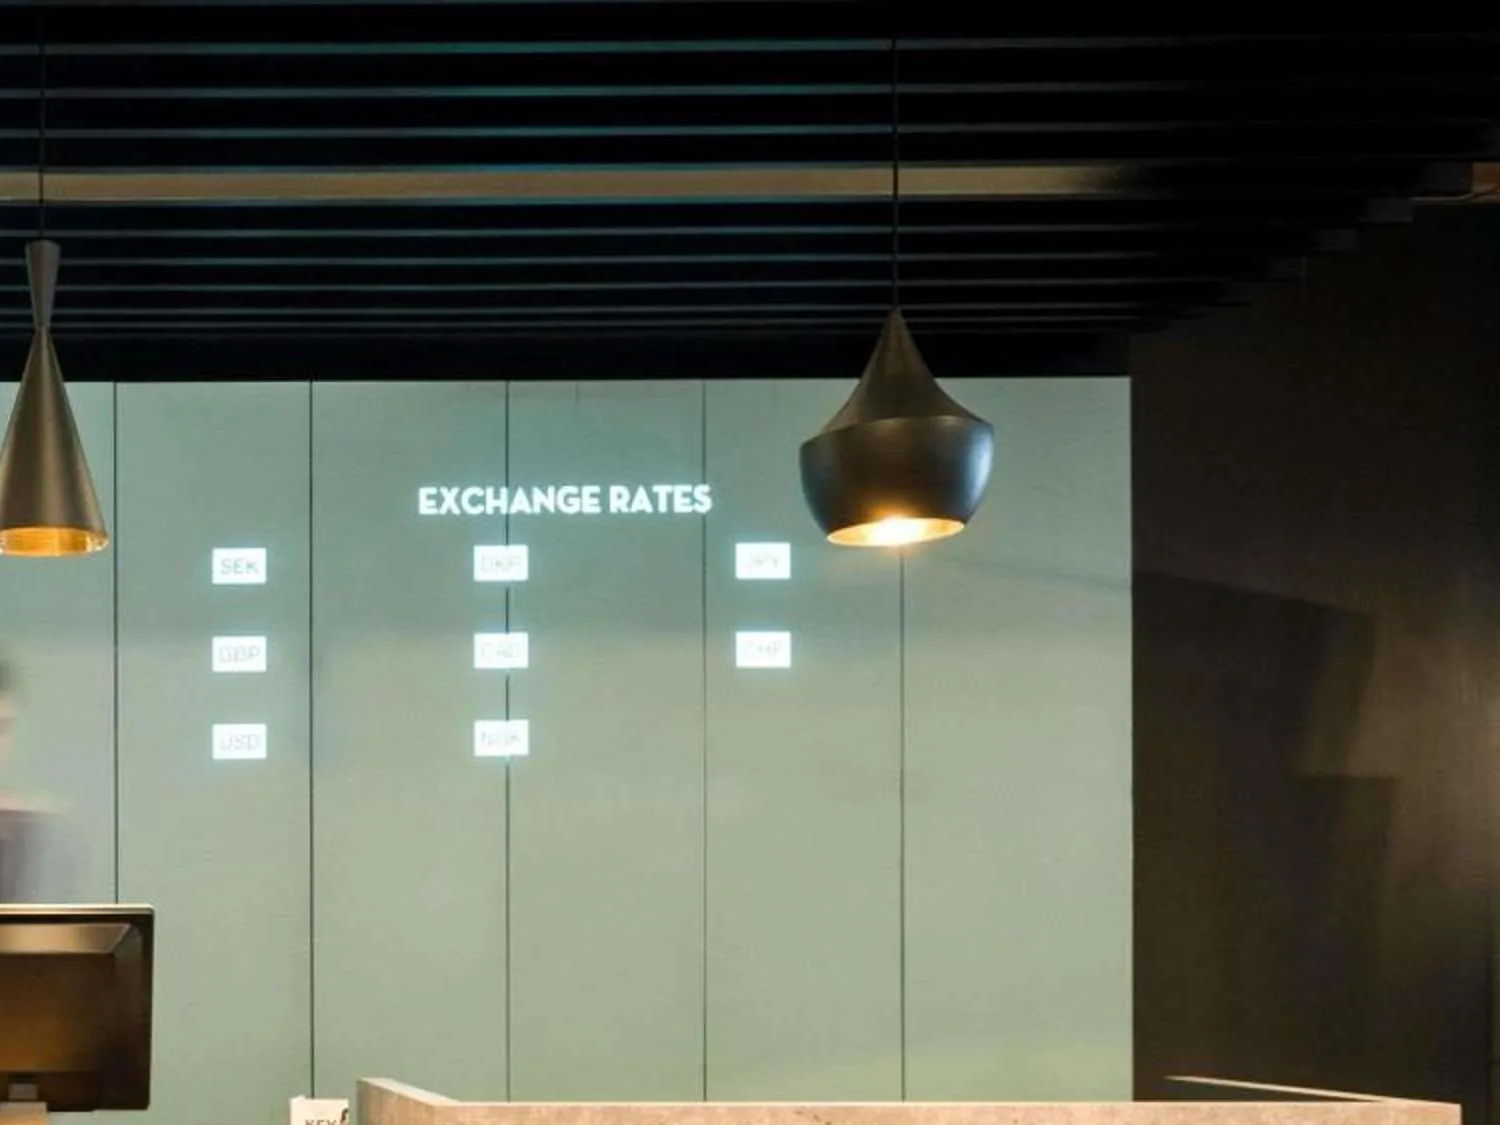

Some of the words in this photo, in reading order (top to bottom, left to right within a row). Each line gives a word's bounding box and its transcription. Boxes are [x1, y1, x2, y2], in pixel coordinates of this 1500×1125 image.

[418, 485, 601, 515] EXCHANGE
[609, 483, 713, 514] RATES
[220, 557, 259, 576] SEK
